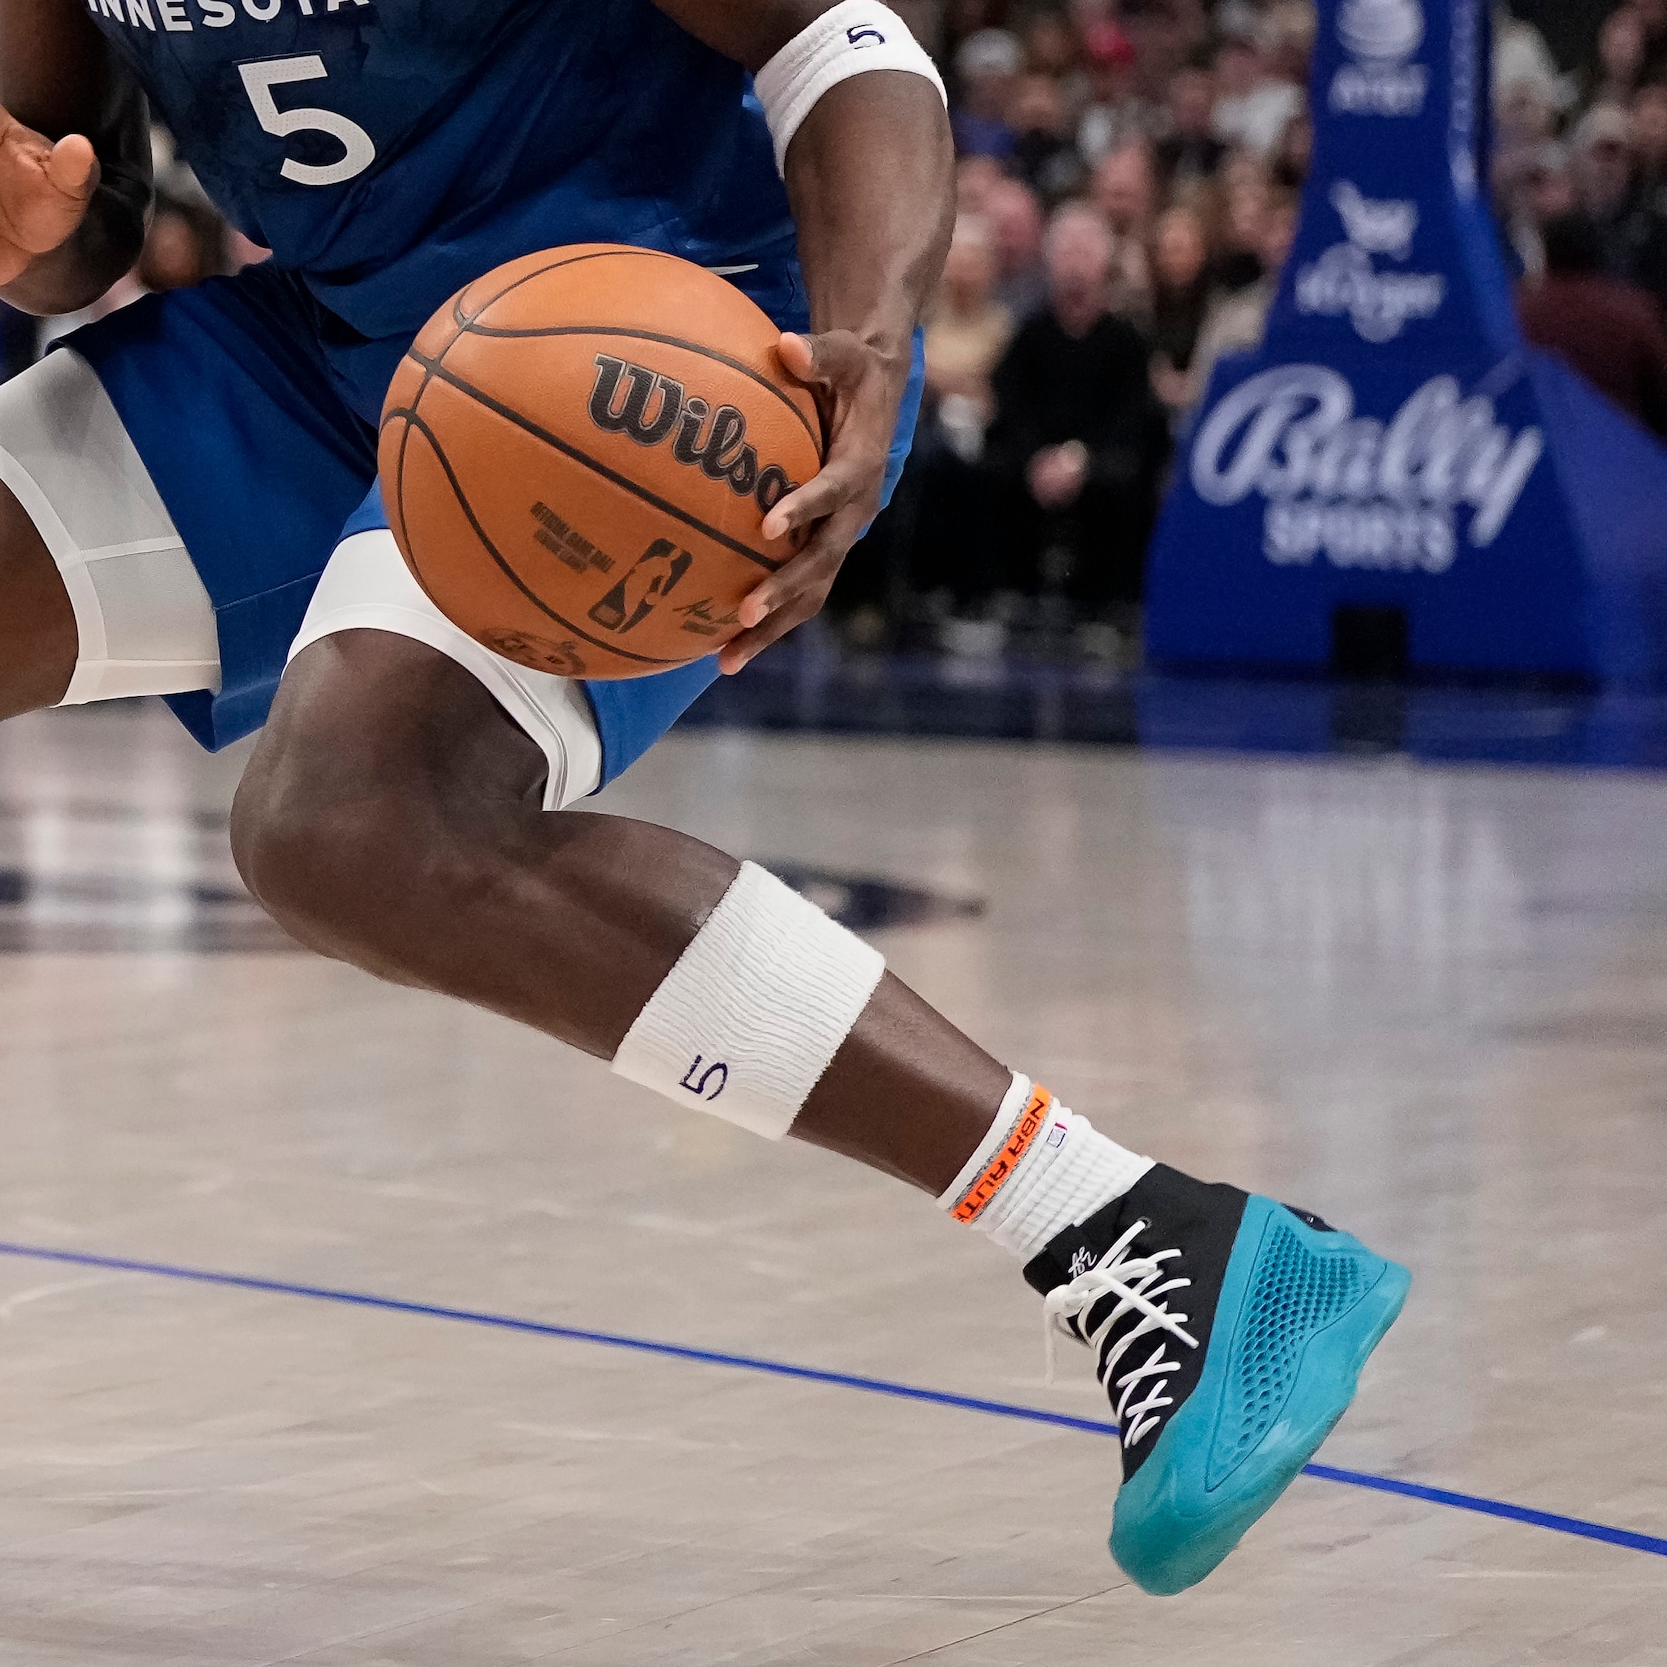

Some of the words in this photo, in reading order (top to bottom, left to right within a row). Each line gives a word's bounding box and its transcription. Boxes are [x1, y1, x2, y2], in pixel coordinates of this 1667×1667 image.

[846, 23, 886, 50] 5
[237, 54, 377, 186] 5
[587, 352, 803, 516] Wilso
[1190, 363, 1544, 547] Bally
[677, 1054, 729, 1102] 5
[1007, 1097, 1046, 1157] NBA
